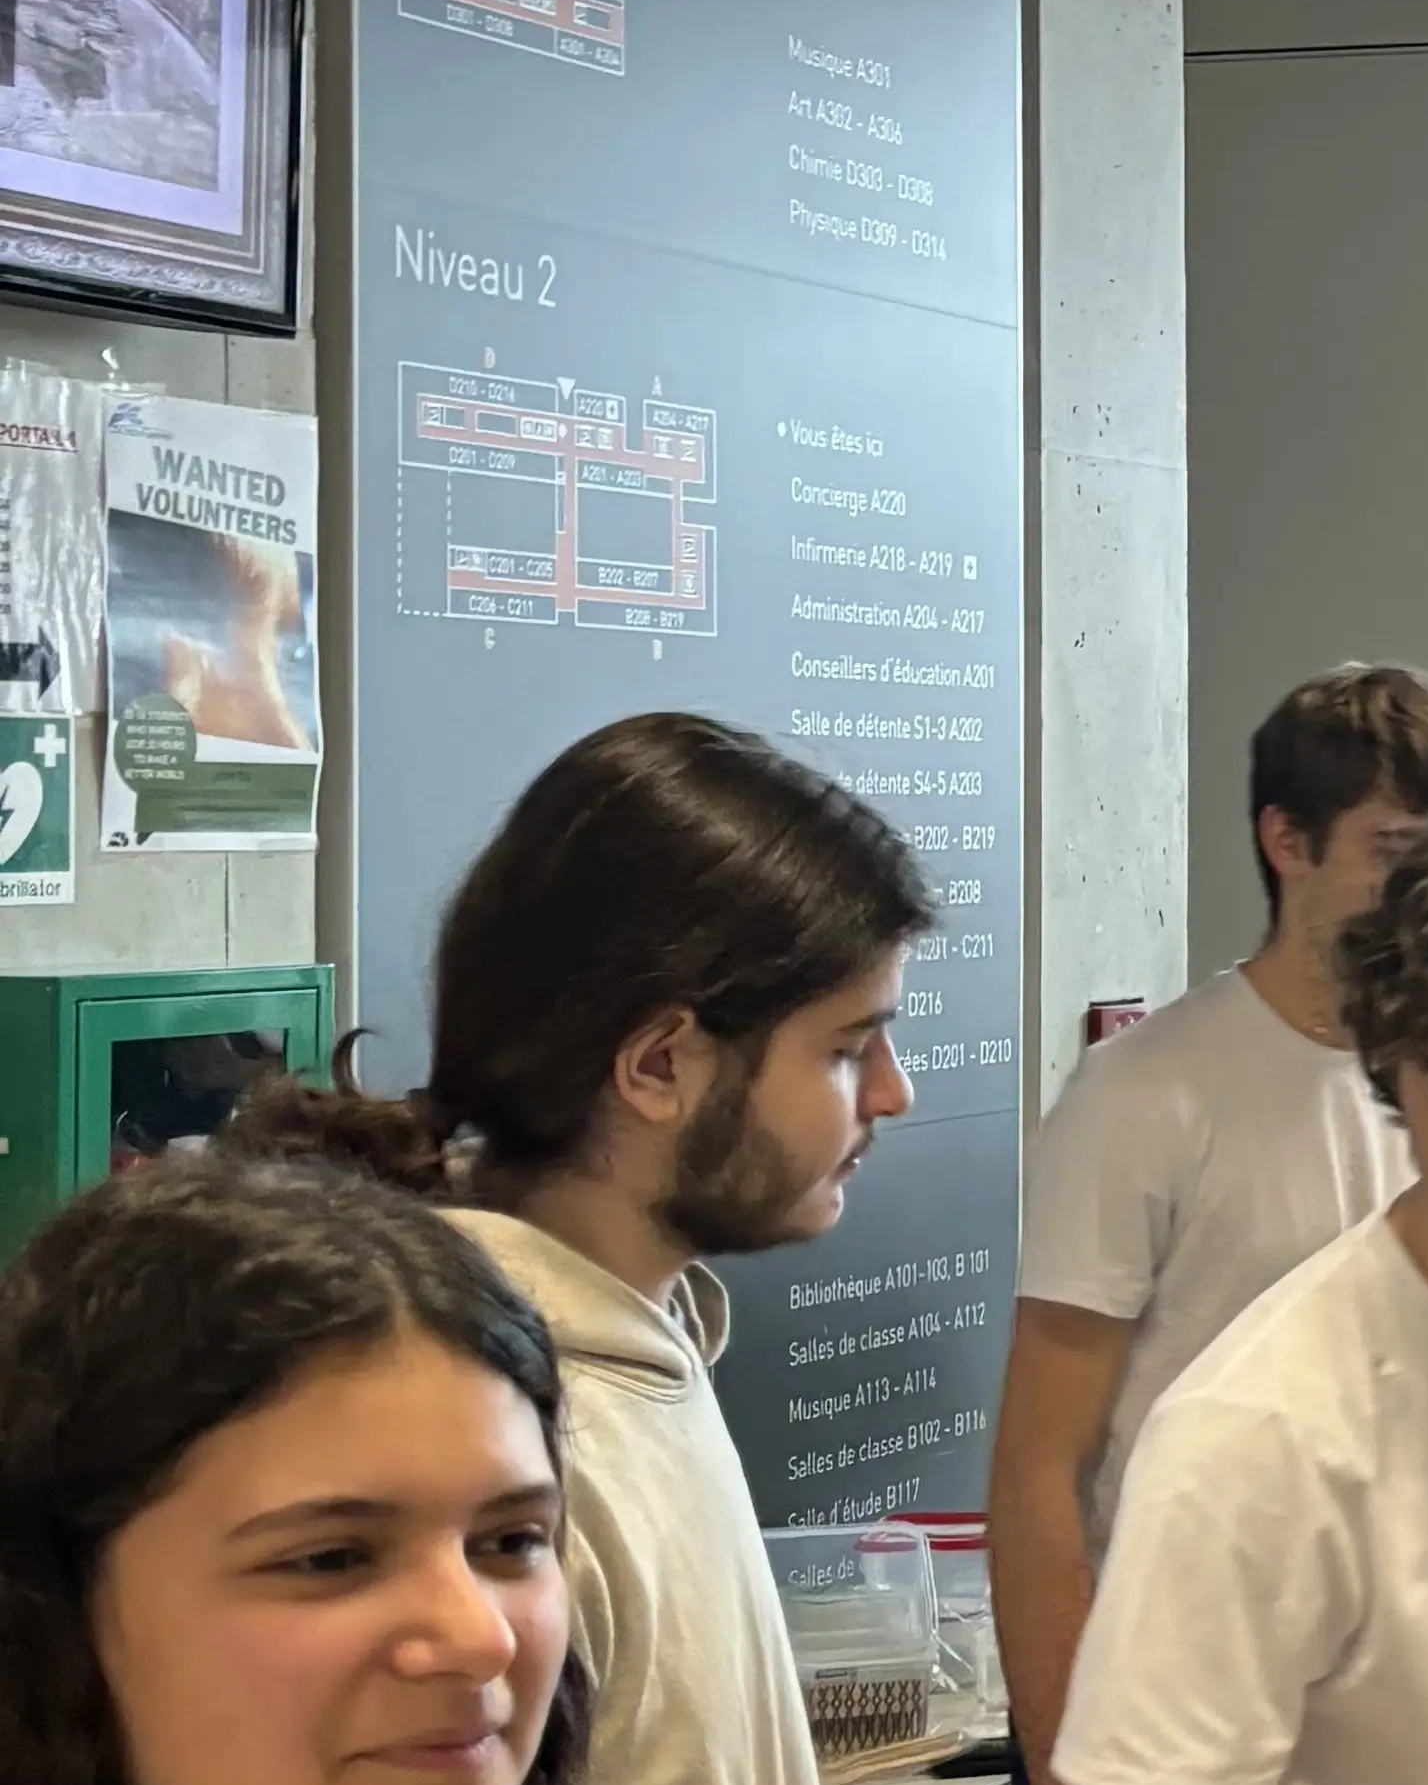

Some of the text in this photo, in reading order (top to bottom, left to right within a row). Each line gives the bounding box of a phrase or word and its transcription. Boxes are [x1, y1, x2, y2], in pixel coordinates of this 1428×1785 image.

[788, 34, 891, 90] Musique A301
[788, 90, 813, 120] Art
[816, 98, 853, 131] A302
[867, 114, 903, 145] A306
[789, 143, 843, 181] Chimie
[846, 159, 883, 192] D303
[898, 174, 934, 207] D308
[789, 198, 858, 241] Physique
[861, 216, 897, 248] D309
[912, 229, 948, 261] D314
[395, 224, 556, 307] Niveau 2
[790, 418, 884, 457] Vous êtes ici
[152, 445, 286, 509] WANTED
[791, 476, 907, 518] Concierge A220
[135, 482, 297, 546] VOLUNTEERS
[791, 534, 867, 568] Infirmerie
[869, 544, 906, 572] A218
[919, 551, 953, 578] A219
[791, 593, 901, 627] Administration
[903, 604, 938, 630] A204
[951, 609, 985, 634] A217
[791, 651, 995, 689] Conseillers d'éducation A201
[791, 709, 983, 742] Salle de détente S1-3 A202
[856, 769, 911, 796] détente
[914, 770, 946, 796] S4-5
[949, 771, 982, 796] A203
[914, 825, 949, 850] B202
[962, 825, 996, 850] B219
[948, 879, 982, 904] B208
[960, 933, 993, 958] C211
[908, 991, 943, 1017] D216
[932, 1043, 965, 1070] D201
[980, 1038, 1012, 1065] D210
[790, 1249, 989, 1310] Bibliothèque A101-103, B 101
[789, 1336, 834, 1367] Salles
[839, 1331, 856, 1356] de
[860, 1326, 904, 1351] classe
[908, 1311, 941, 1340] A104
[954, 1301, 985, 1330] A112
[789, 1393, 851, 1423] Musique
[855, 1377, 890, 1407] A113
[903, 1367, 937, 1395] A114
[788, 1451, 833, 1481] Salles
[837, 1444, 855, 1468] de
[858, 1436, 904, 1463] classe
[908, 1419, 941, 1450] B102
[955, 1409, 986, 1437] B116
[829, 1491, 882, 1526] d'étude
[886, 1477, 920, 1510] B117
[837, 1555, 855, 1580] de
